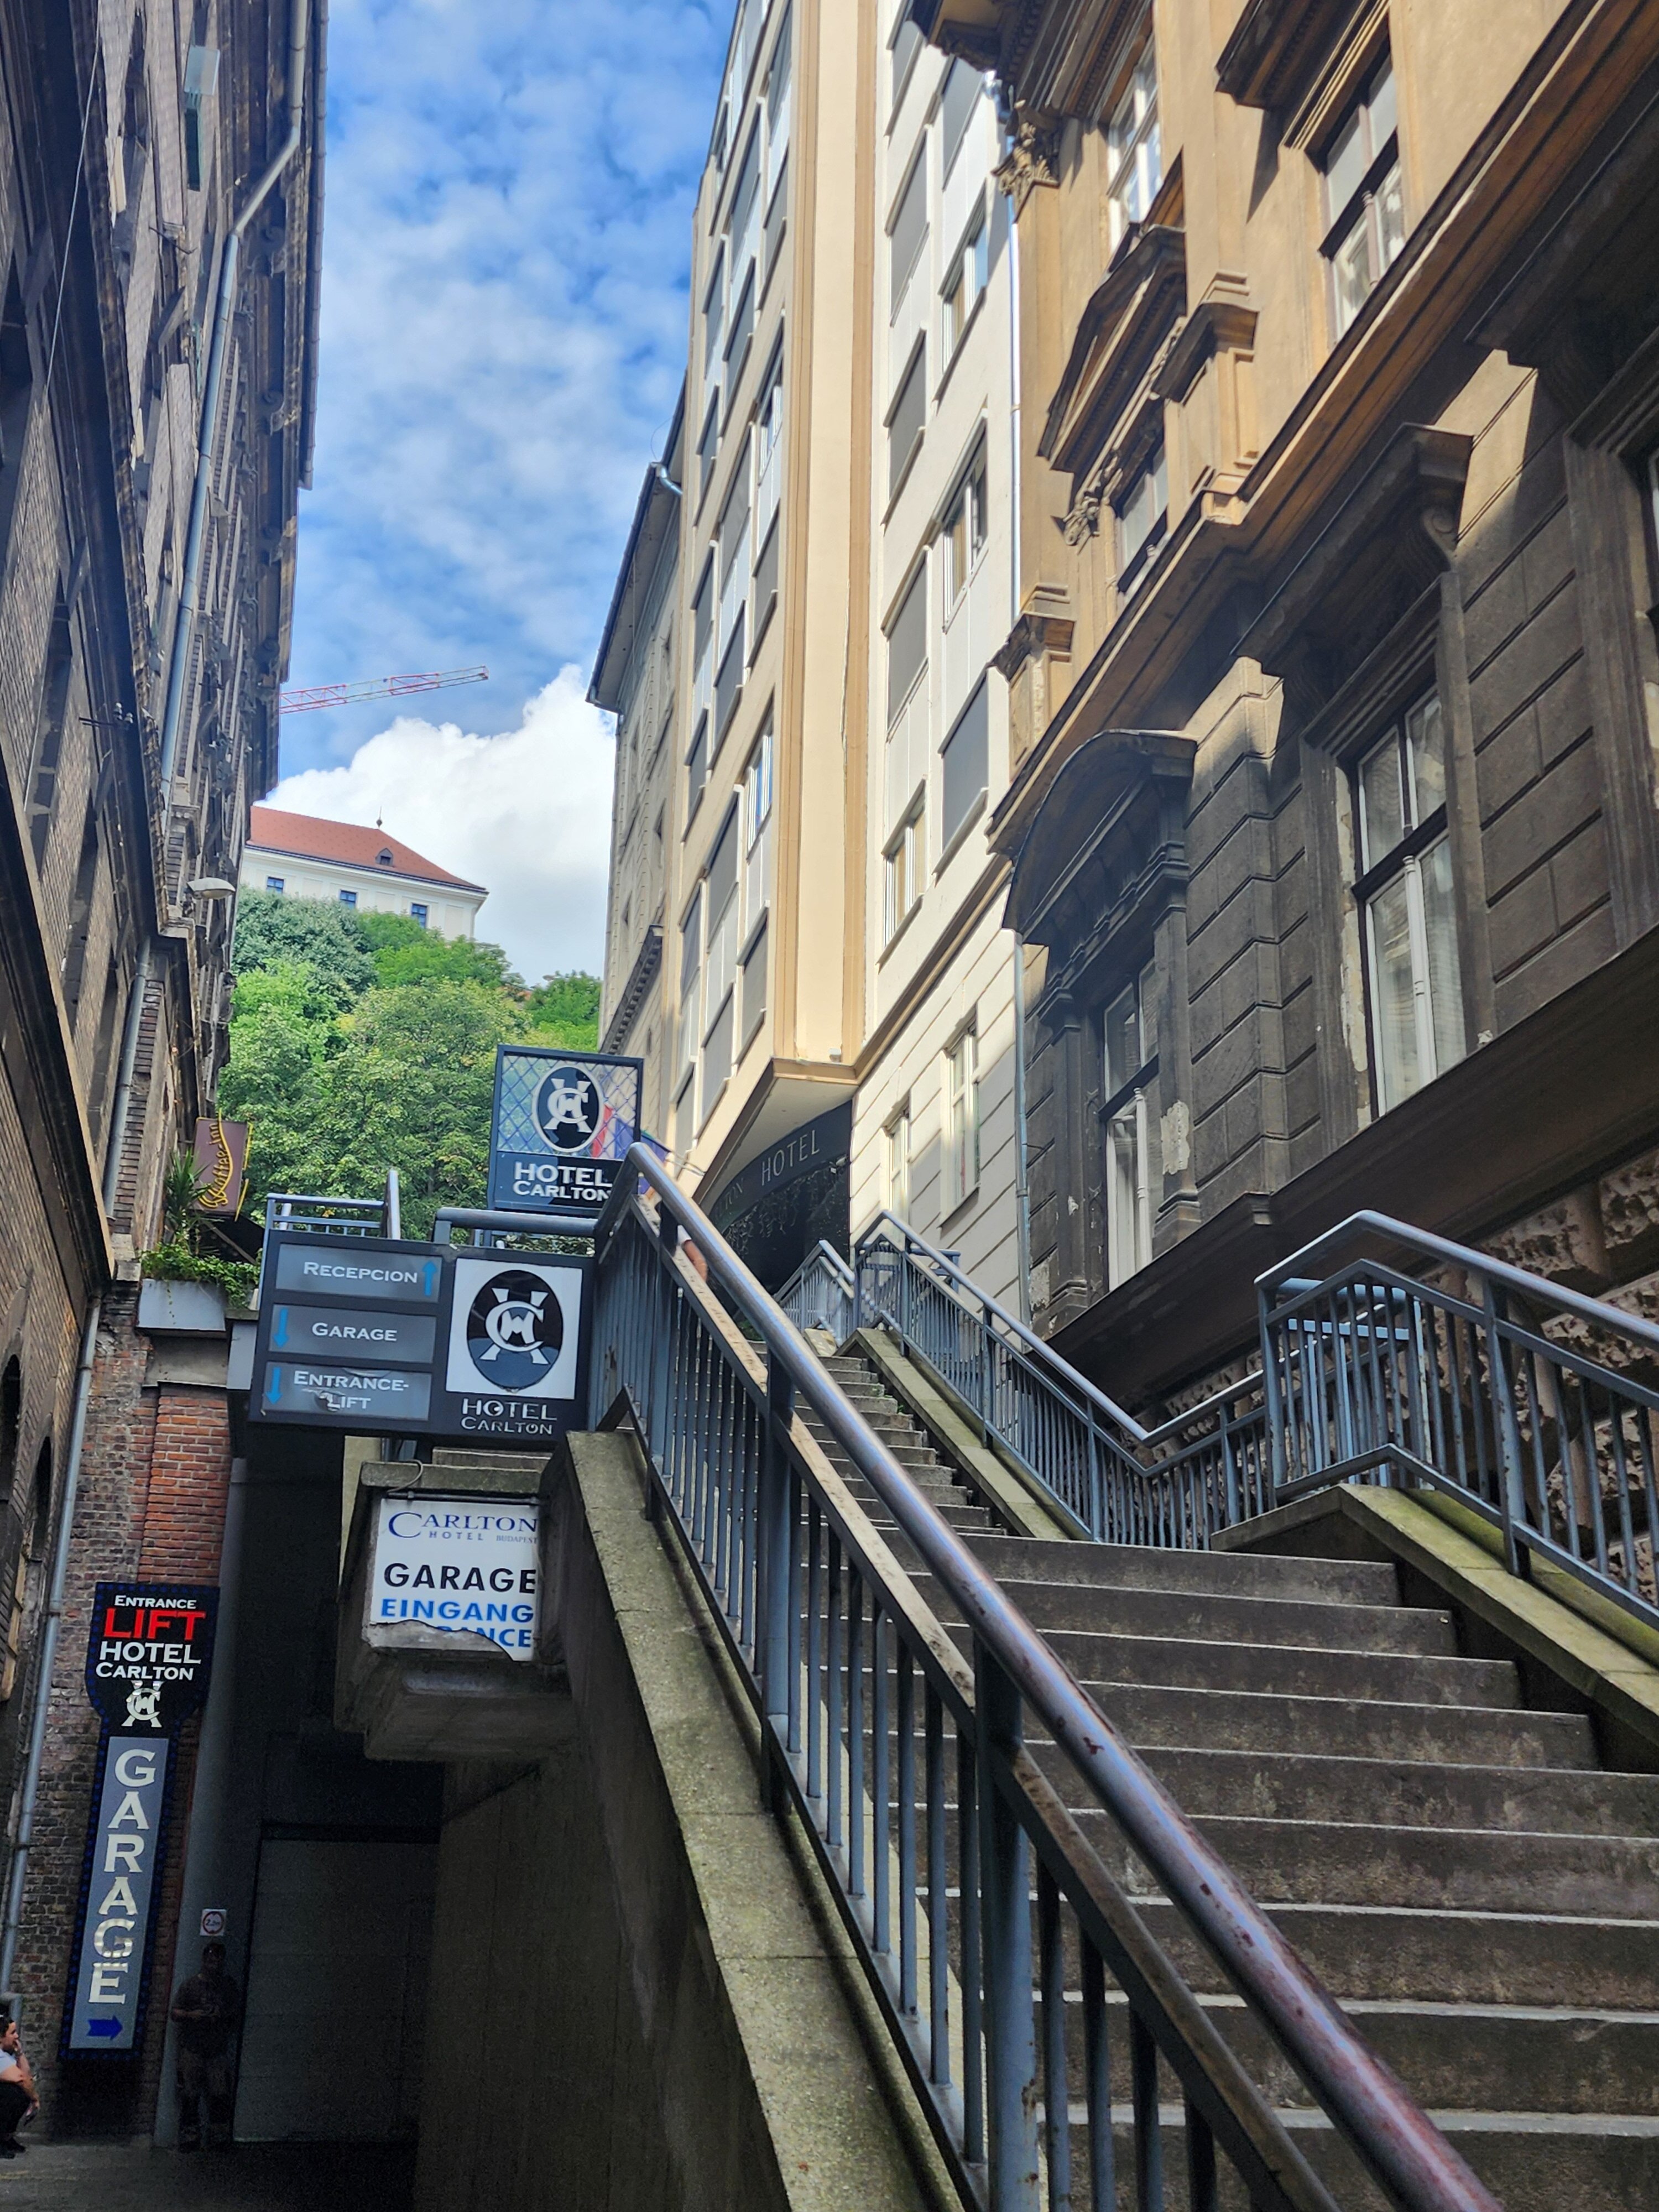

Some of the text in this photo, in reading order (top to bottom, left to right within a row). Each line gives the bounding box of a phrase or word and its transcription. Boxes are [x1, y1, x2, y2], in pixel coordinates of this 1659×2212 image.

[761, 1130, 820, 1186] HOTEL
[515, 1162, 613, 1187] HOTEL
[513, 1181, 612, 1201] CARLTON
[304, 1262, 418, 1283] RECEPCION
[311, 1323, 398, 1342] GARAGE
[462, 1399, 557, 1421] HOTEL
[461, 1417, 552, 1434] CARLTON
[388, 1512, 537, 1538] CARLTON
[429, 1531, 484, 1541] HOTEL
[384, 1563, 536, 1594] GARAGE
[114, 1595, 197, 1609] ENTRANCE
[380, 1598, 534, 1623] EINGANG
[103, 1608, 206, 1641] LIFT
[99, 1641, 201, 1665] HOTEL
[96, 1662, 194, 1681] CARLTON
[88, 1749, 156, 2004] GARAGE
